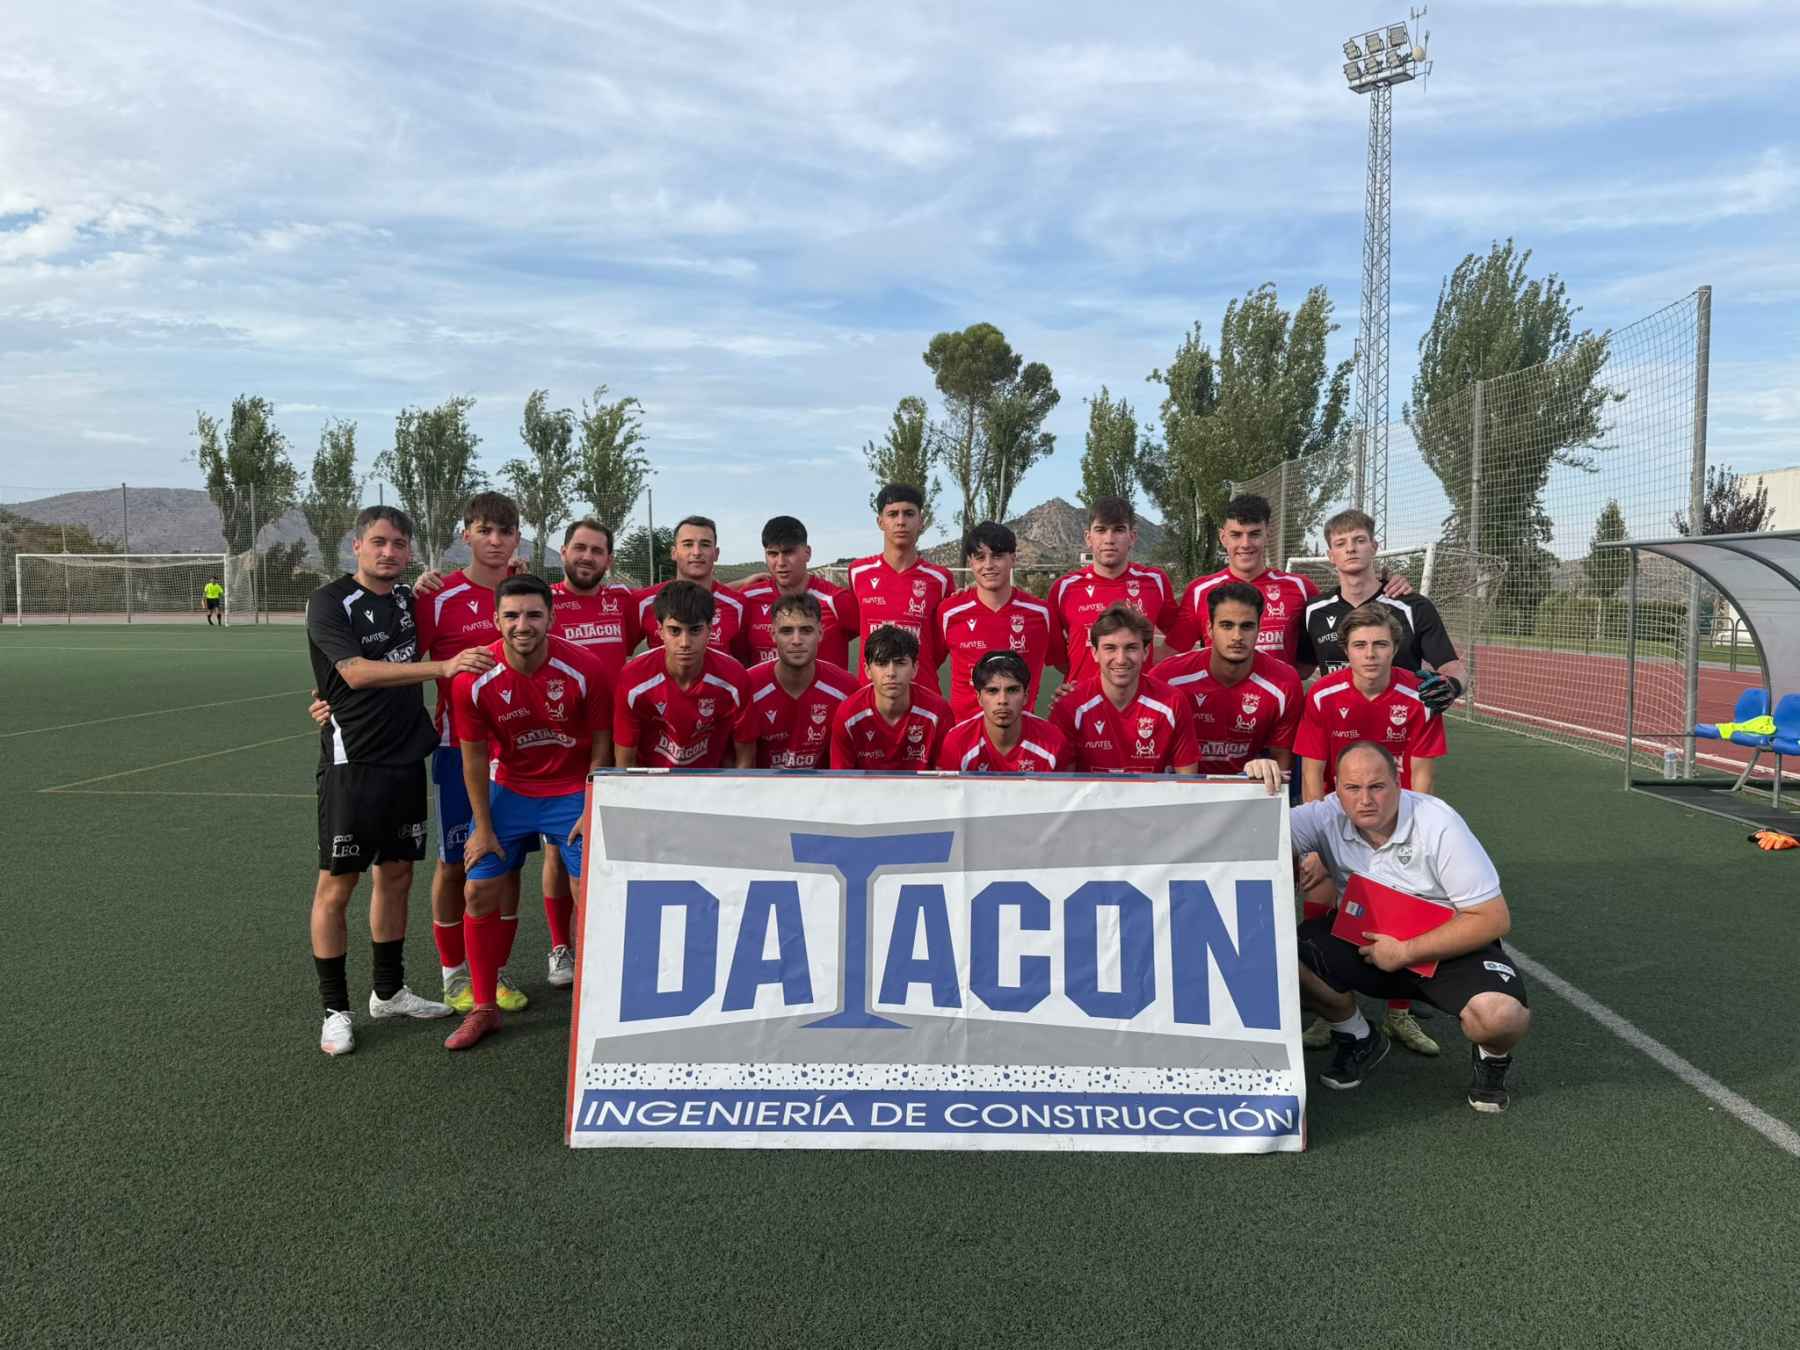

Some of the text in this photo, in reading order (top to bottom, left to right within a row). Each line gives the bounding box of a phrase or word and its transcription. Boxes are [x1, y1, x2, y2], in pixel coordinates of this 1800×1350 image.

[564, 623, 621, 640] DATACON
[619, 831, 1281, 1029] DATACON
[583, 1095, 1293, 1131] INGENIERÍA DE CONSTRUCCIÓN
